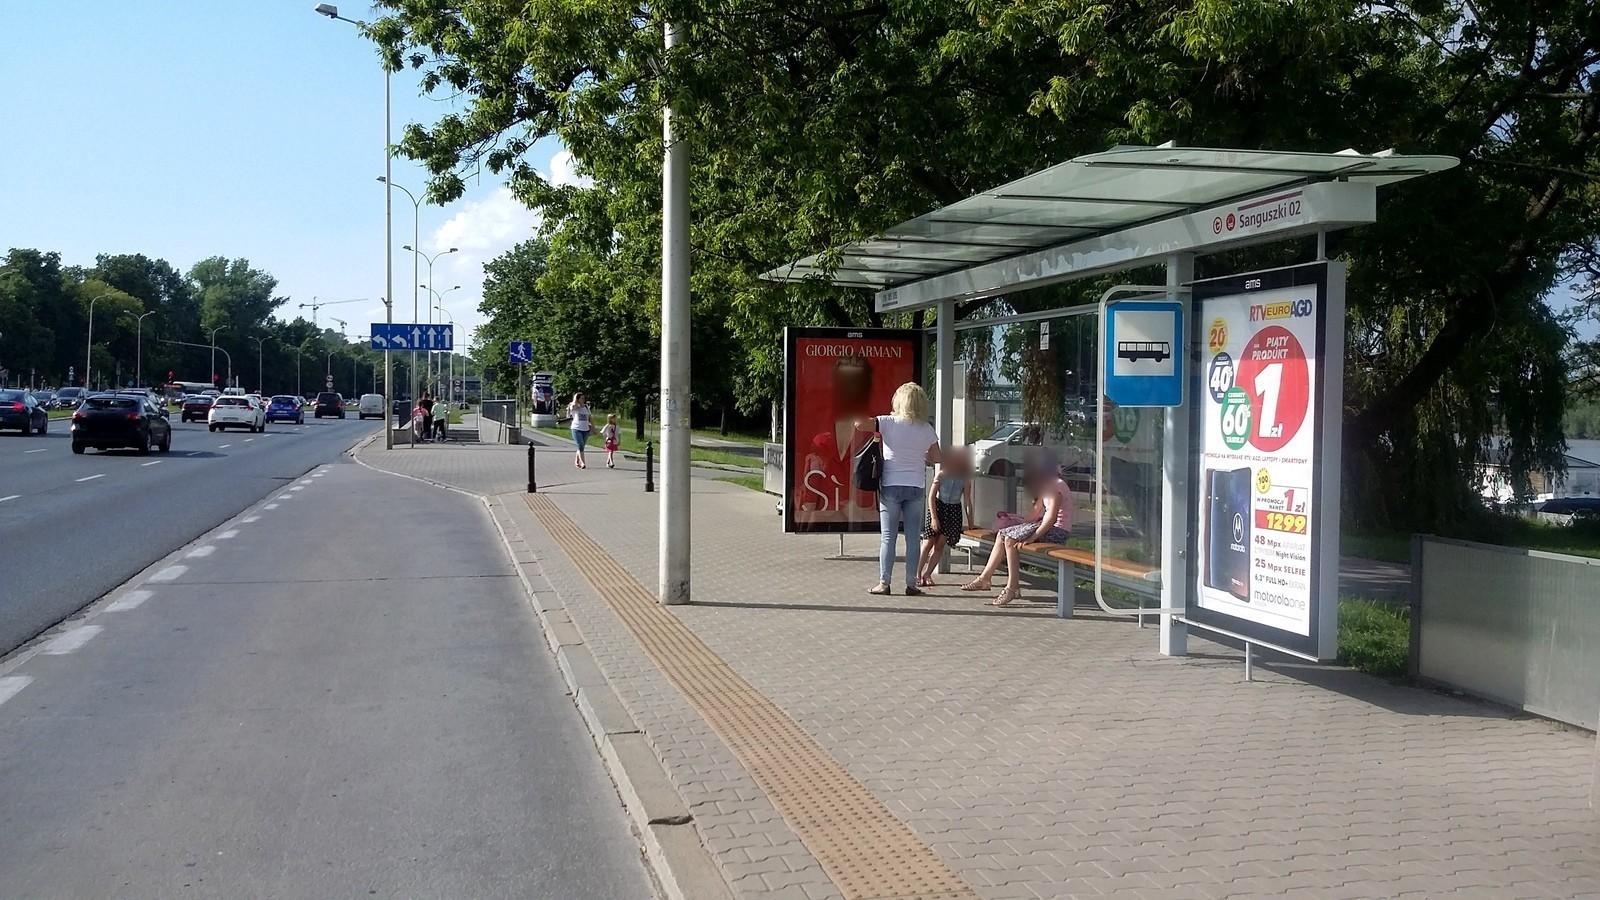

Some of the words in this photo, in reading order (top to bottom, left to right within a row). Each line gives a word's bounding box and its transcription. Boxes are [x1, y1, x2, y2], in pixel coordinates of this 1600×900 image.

[1239, 203, 1287, 229] Sanguszki
[1289, 200, 1301, 216] 02
[1245, 279, 1260, 290] ams
[805, 344, 854, 357] GIORGIO
[858, 345, 902, 358] ARMANI
[1252, 348, 1288, 361] PRODUKT
[1254, 363, 1283, 437] 1
[1284, 489, 1294, 512] 1
[1266, 512, 1306, 532] 1299
[1254, 535, 1266, 545] 48
[1267, 539, 1281, 549] Mpx
[1255, 558, 1266, 569] 25
[1267, 562, 1282, 572] Mpx
[1283, 565, 1306, 576] SELFIE
